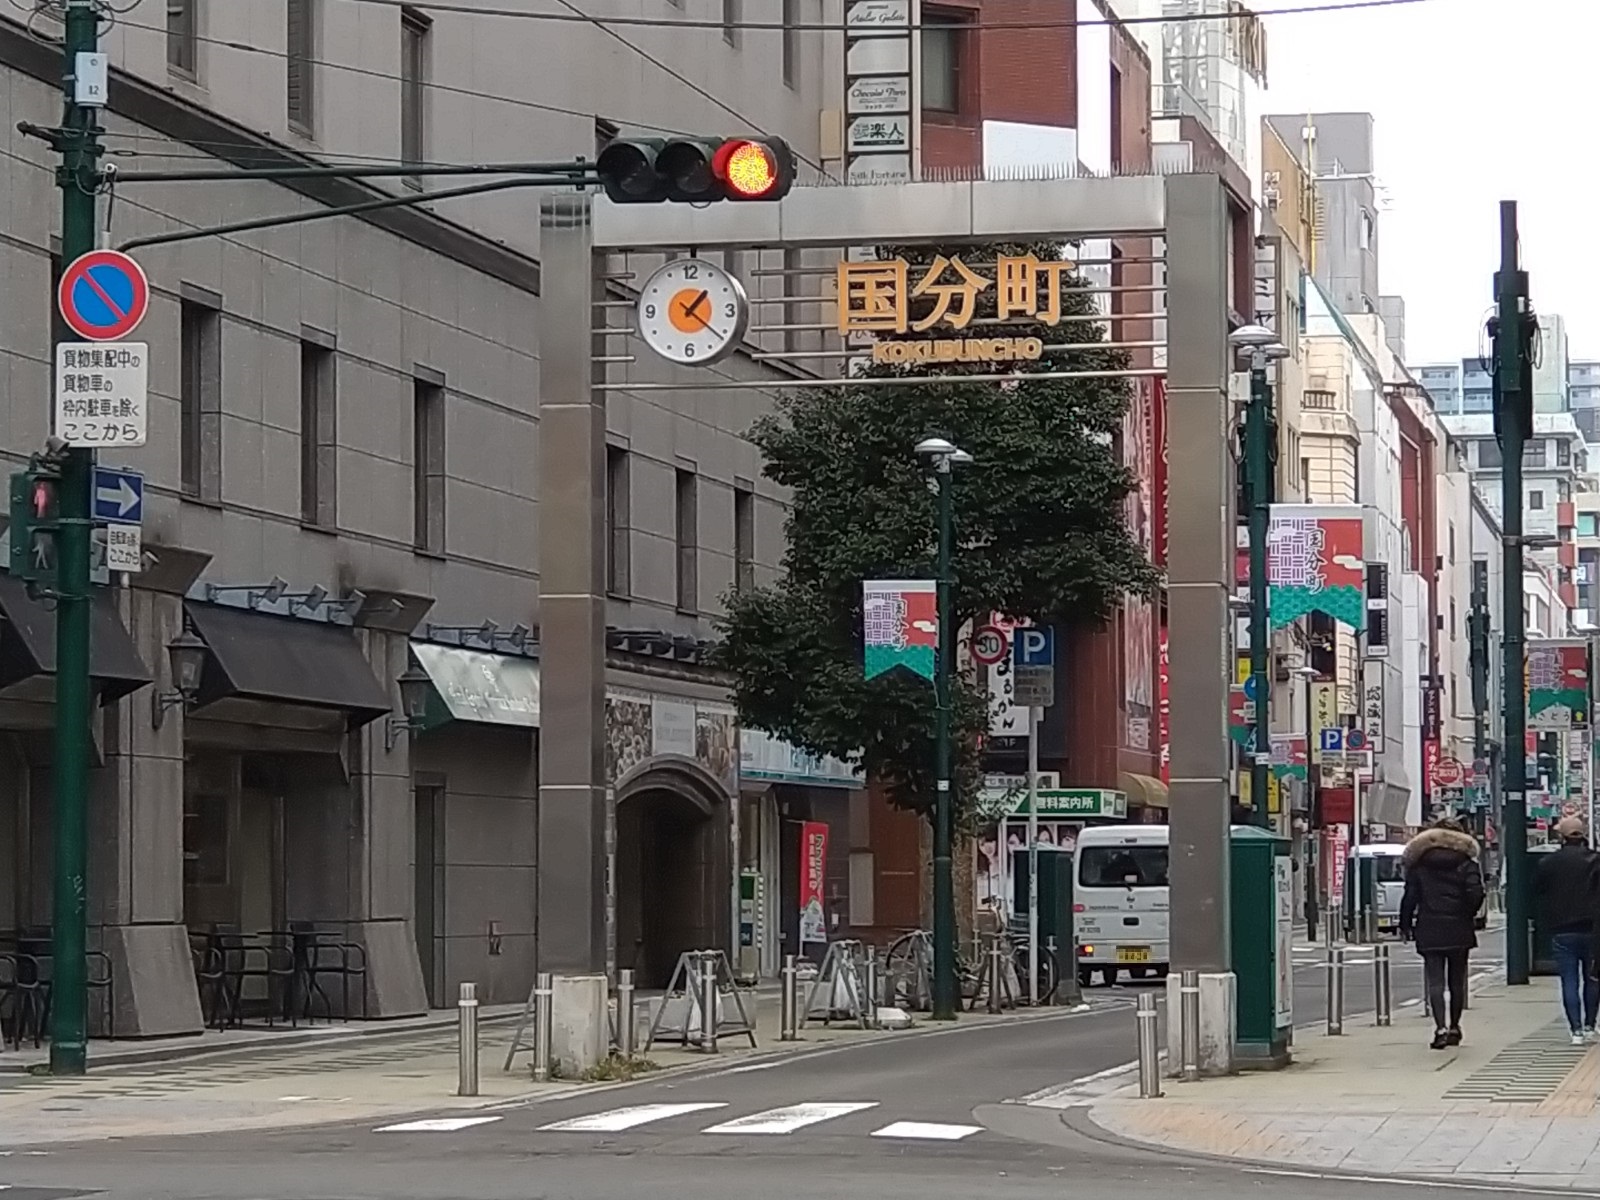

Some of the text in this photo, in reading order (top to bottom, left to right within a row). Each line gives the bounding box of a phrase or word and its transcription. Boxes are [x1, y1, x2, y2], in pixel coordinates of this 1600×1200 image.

[683, 265, 698, 280] 12
[838, 253, 1076, 336] 国分町
[645, 303, 735, 319] 9 3
[63, 349, 140, 369] 貨物集配中の
[684, 343, 695, 358] 6
[873, 338, 1043, 364] KOKUBUNCHO
[63, 374, 113, 393] 貨物車の
[63, 398, 140, 418] 枠内駐車を除く
[63, 423, 139, 441] ここから
[1305, 528, 1326, 594] 国分町
[979, 637, 999, 654] 30
[1024, 631, 1046, 662] P
[1325, 731, 1339, 749] P
